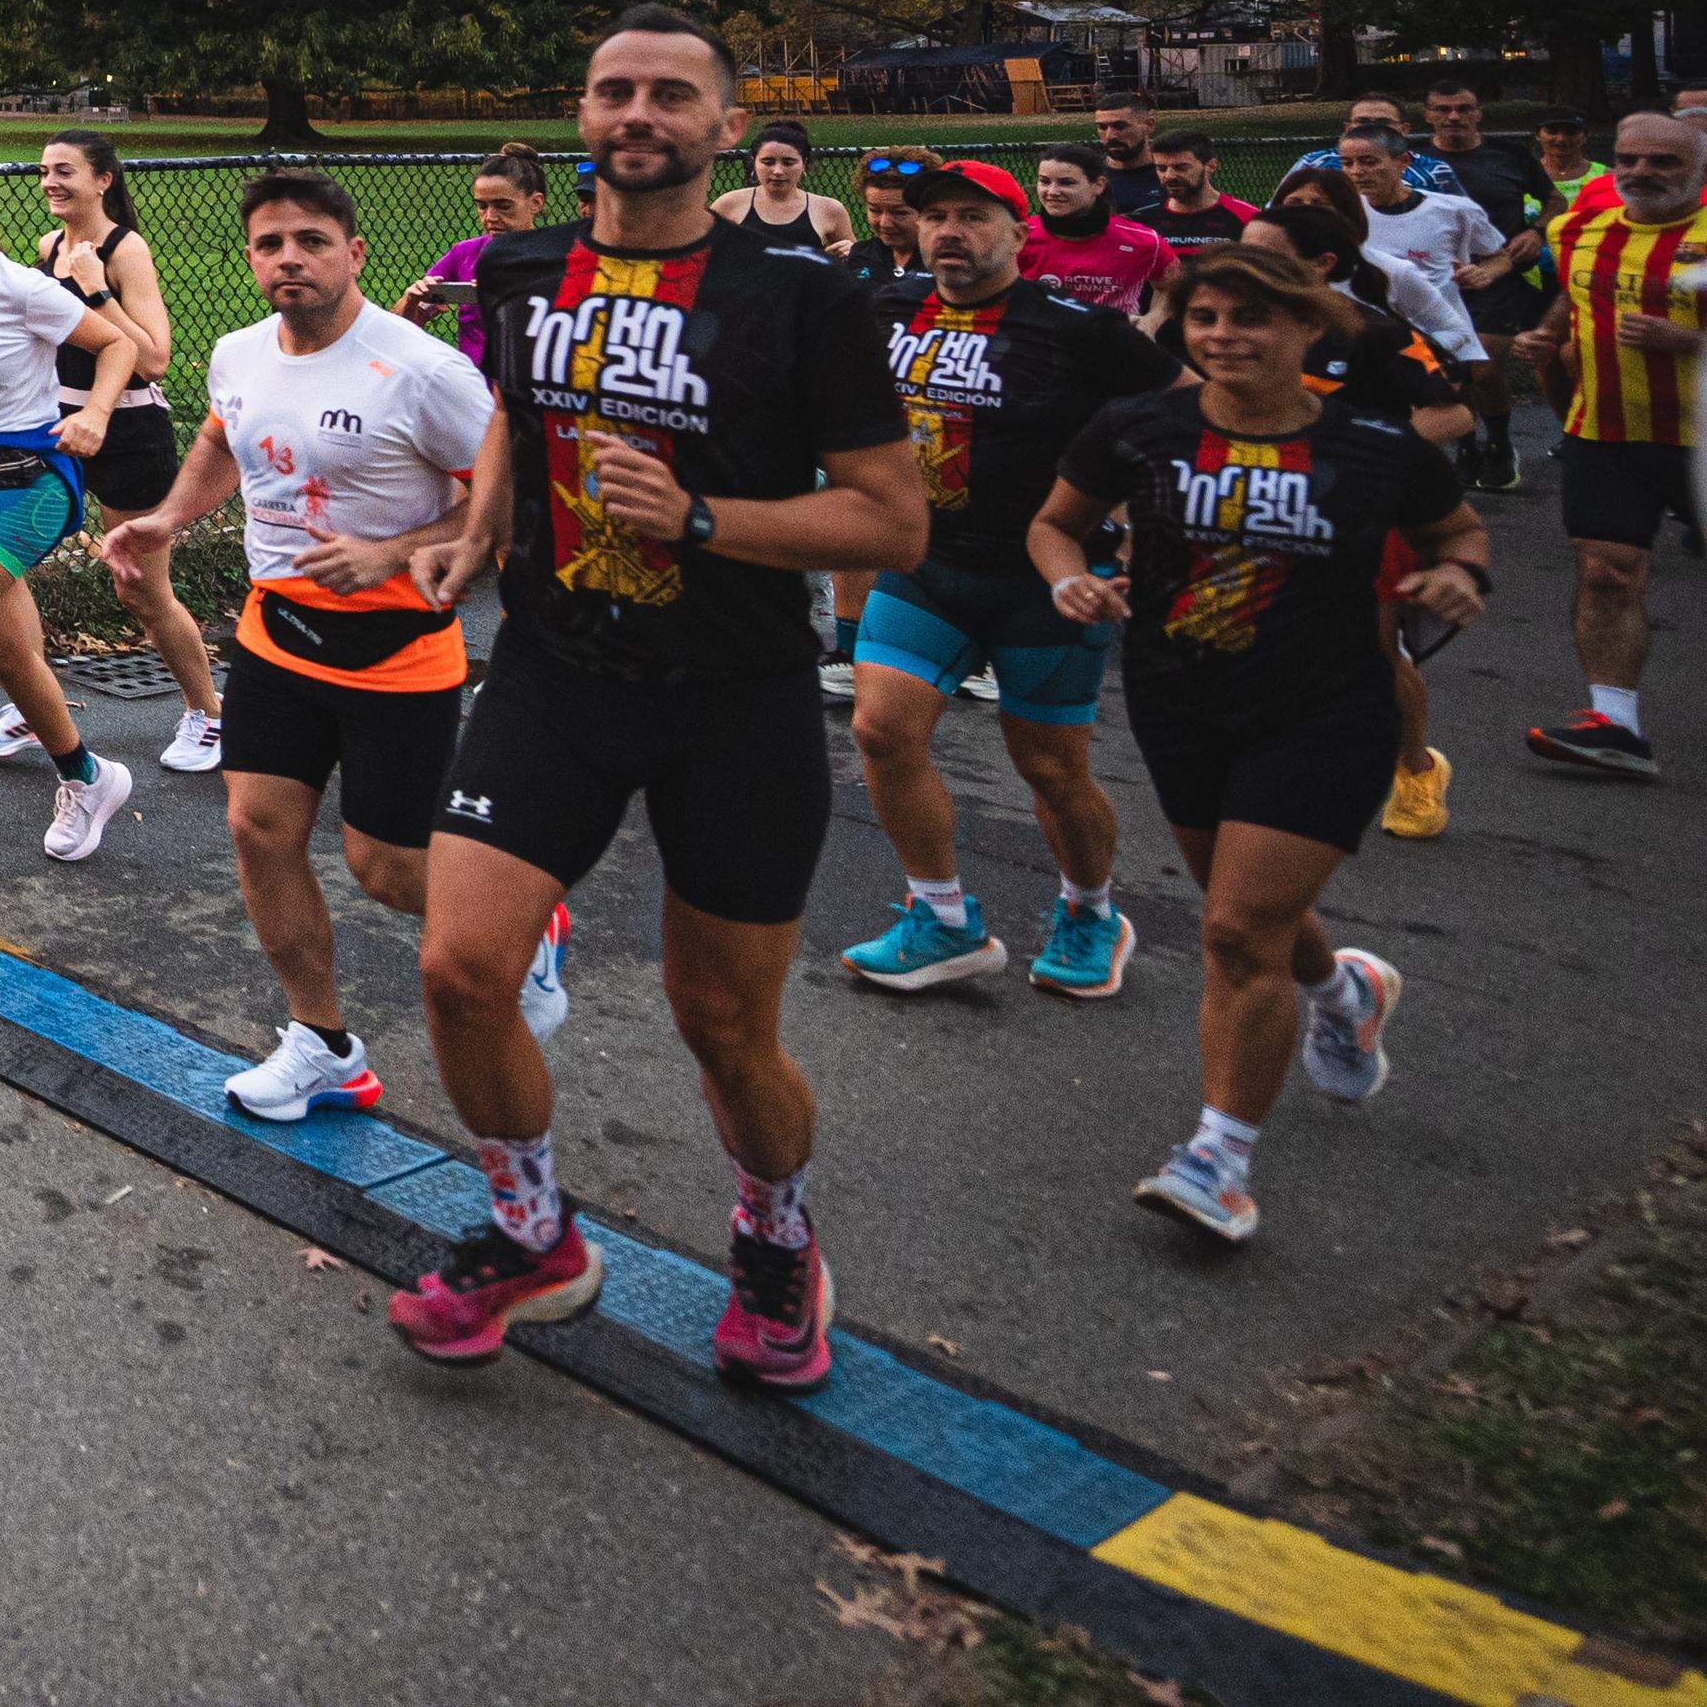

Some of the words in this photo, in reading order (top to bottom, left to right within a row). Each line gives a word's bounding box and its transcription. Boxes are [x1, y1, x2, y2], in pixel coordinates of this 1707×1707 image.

[1064, 275, 1113, 284] ACTIVE
[532, 387, 588, 412] XXIV
[600, 397, 709, 436] EDICIÓN
[926, 387, 1003, 408] EDICIÓN
[259, 435, 295, 476] 13
